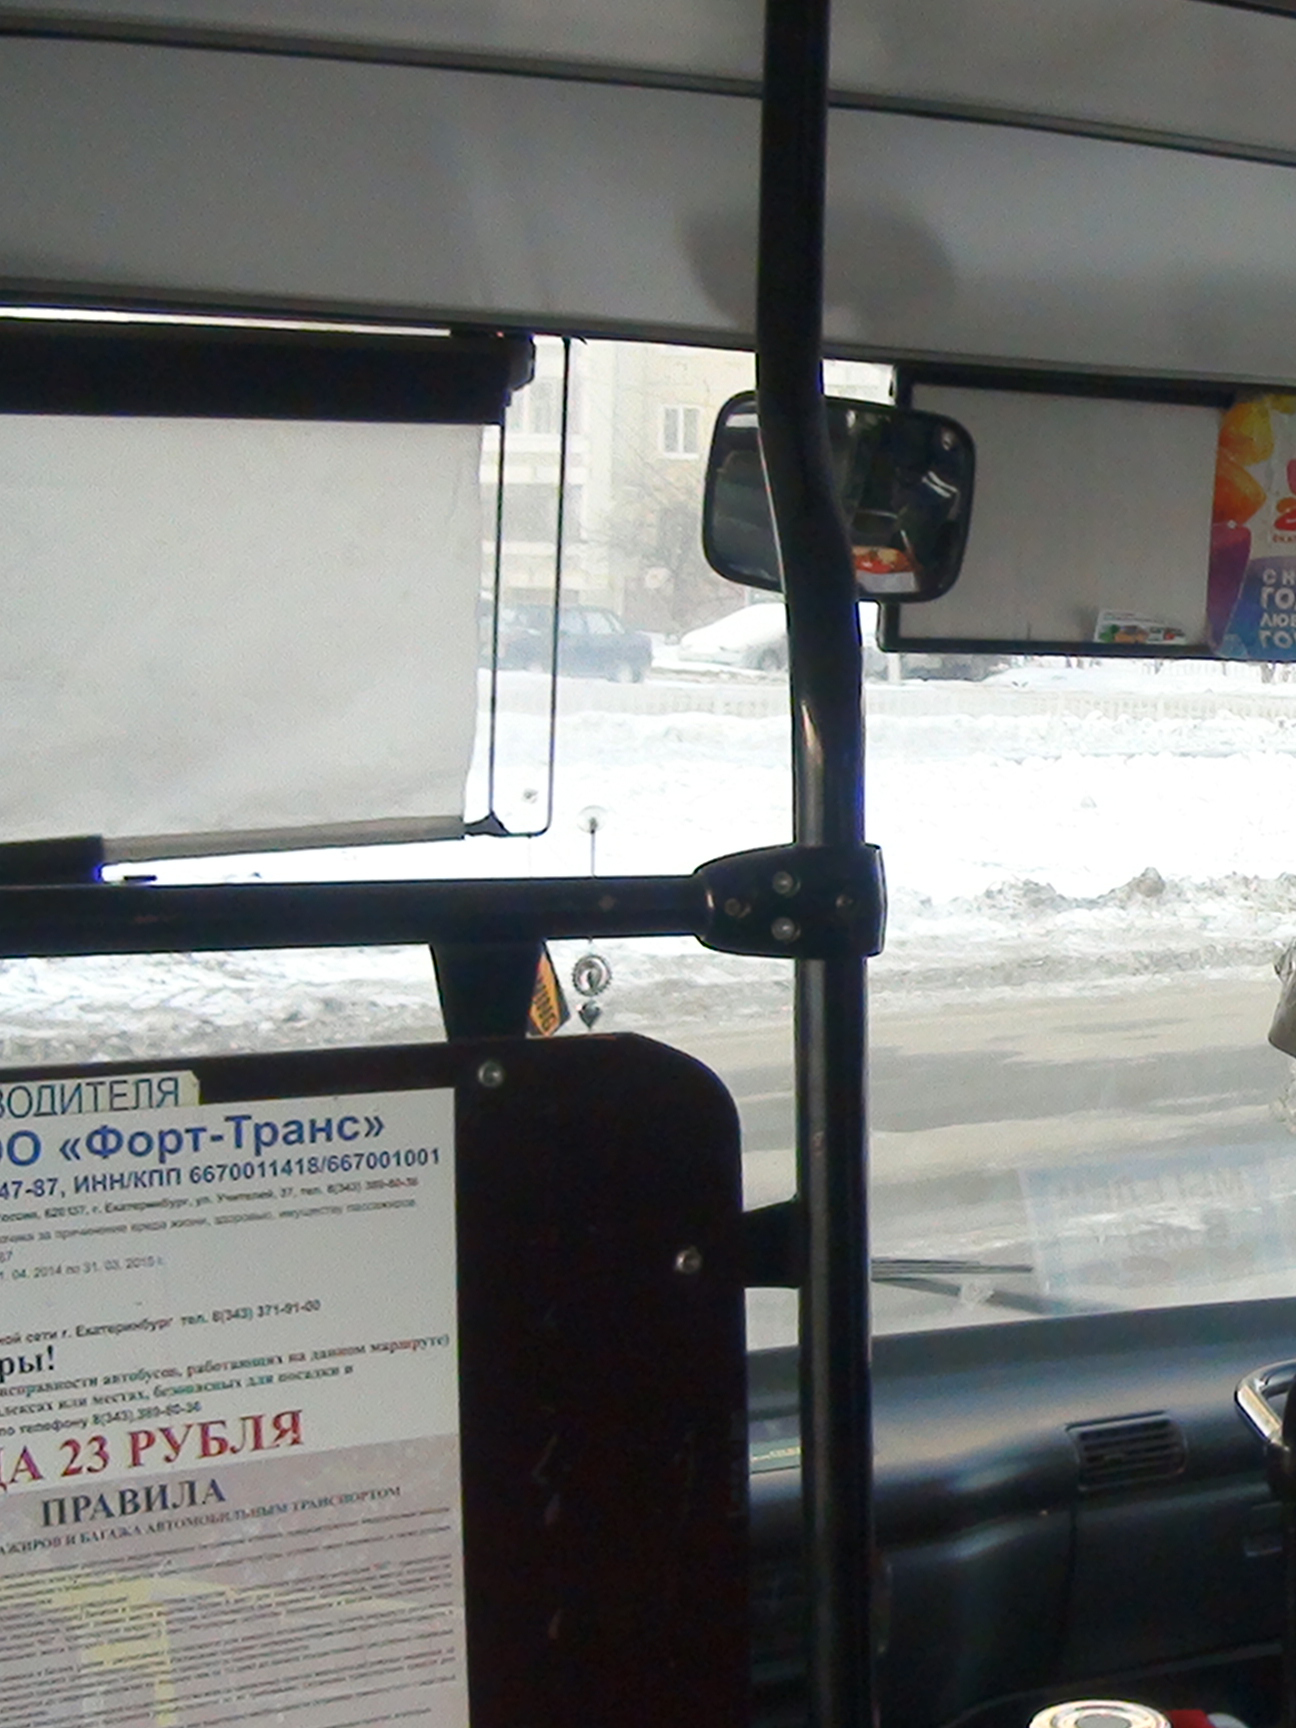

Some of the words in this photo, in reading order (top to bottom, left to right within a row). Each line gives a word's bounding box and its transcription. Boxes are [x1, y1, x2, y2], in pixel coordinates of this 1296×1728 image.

[1262, 568, 1277, 585] С
[0, 1077, 179, 1118] ОДИТЕЛЯ
[0, 1130, 41, 1166] О
[59, 1114, 385, 1164] «Форт-Транс»
[74, 1168, 181, 1194] ИНН/КПП
[60, 1434, 110, 1477] 23
[128, 1409, 304, 1468] РУБЛЯ
[42, 1478, 227, 1527] ПРАВИЛА
